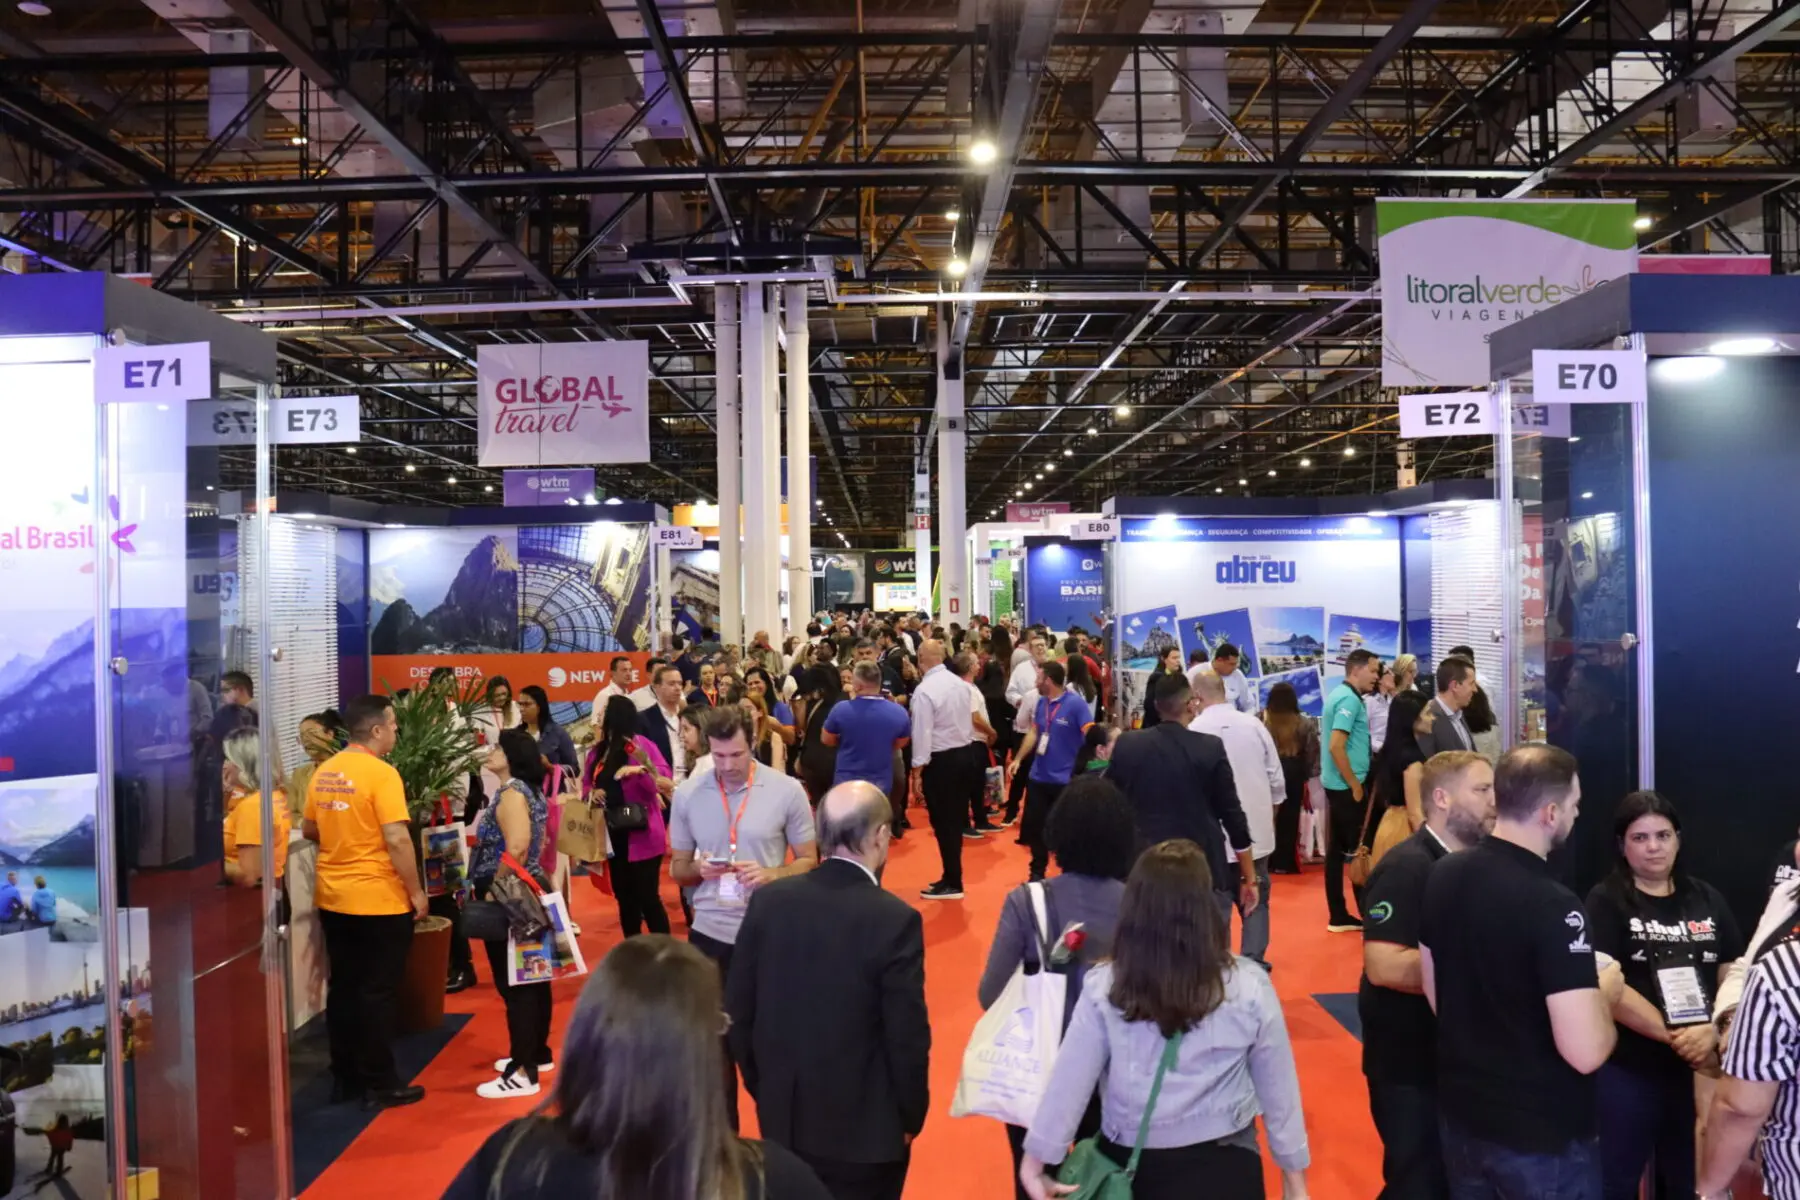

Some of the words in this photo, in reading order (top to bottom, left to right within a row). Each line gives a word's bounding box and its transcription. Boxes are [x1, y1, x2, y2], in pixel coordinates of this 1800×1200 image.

[1407, 274, 1561, 304] litoralverde
[124, 358, 182, 389] E71
[1558, 364, 1618, 390] E70
[495, 375, 624, 404] GLOBAL
[288, 408, 338, 432] E73
[495, 402, 580, 434] travel
[1425, 403, 1481, 425] E72
[541, 476, 569, 487] wtm
[27, 525, 94, 549] Brasil
[660, 530, 682, 540] E81
[1088, 523, 1110, 532] E80
[892, 559, 916, 571] wt
[1216, 555, 1295, 583] abreu
[410, 667, 482, 677] DESBRA
[570, 671, 605, 683] NEW
